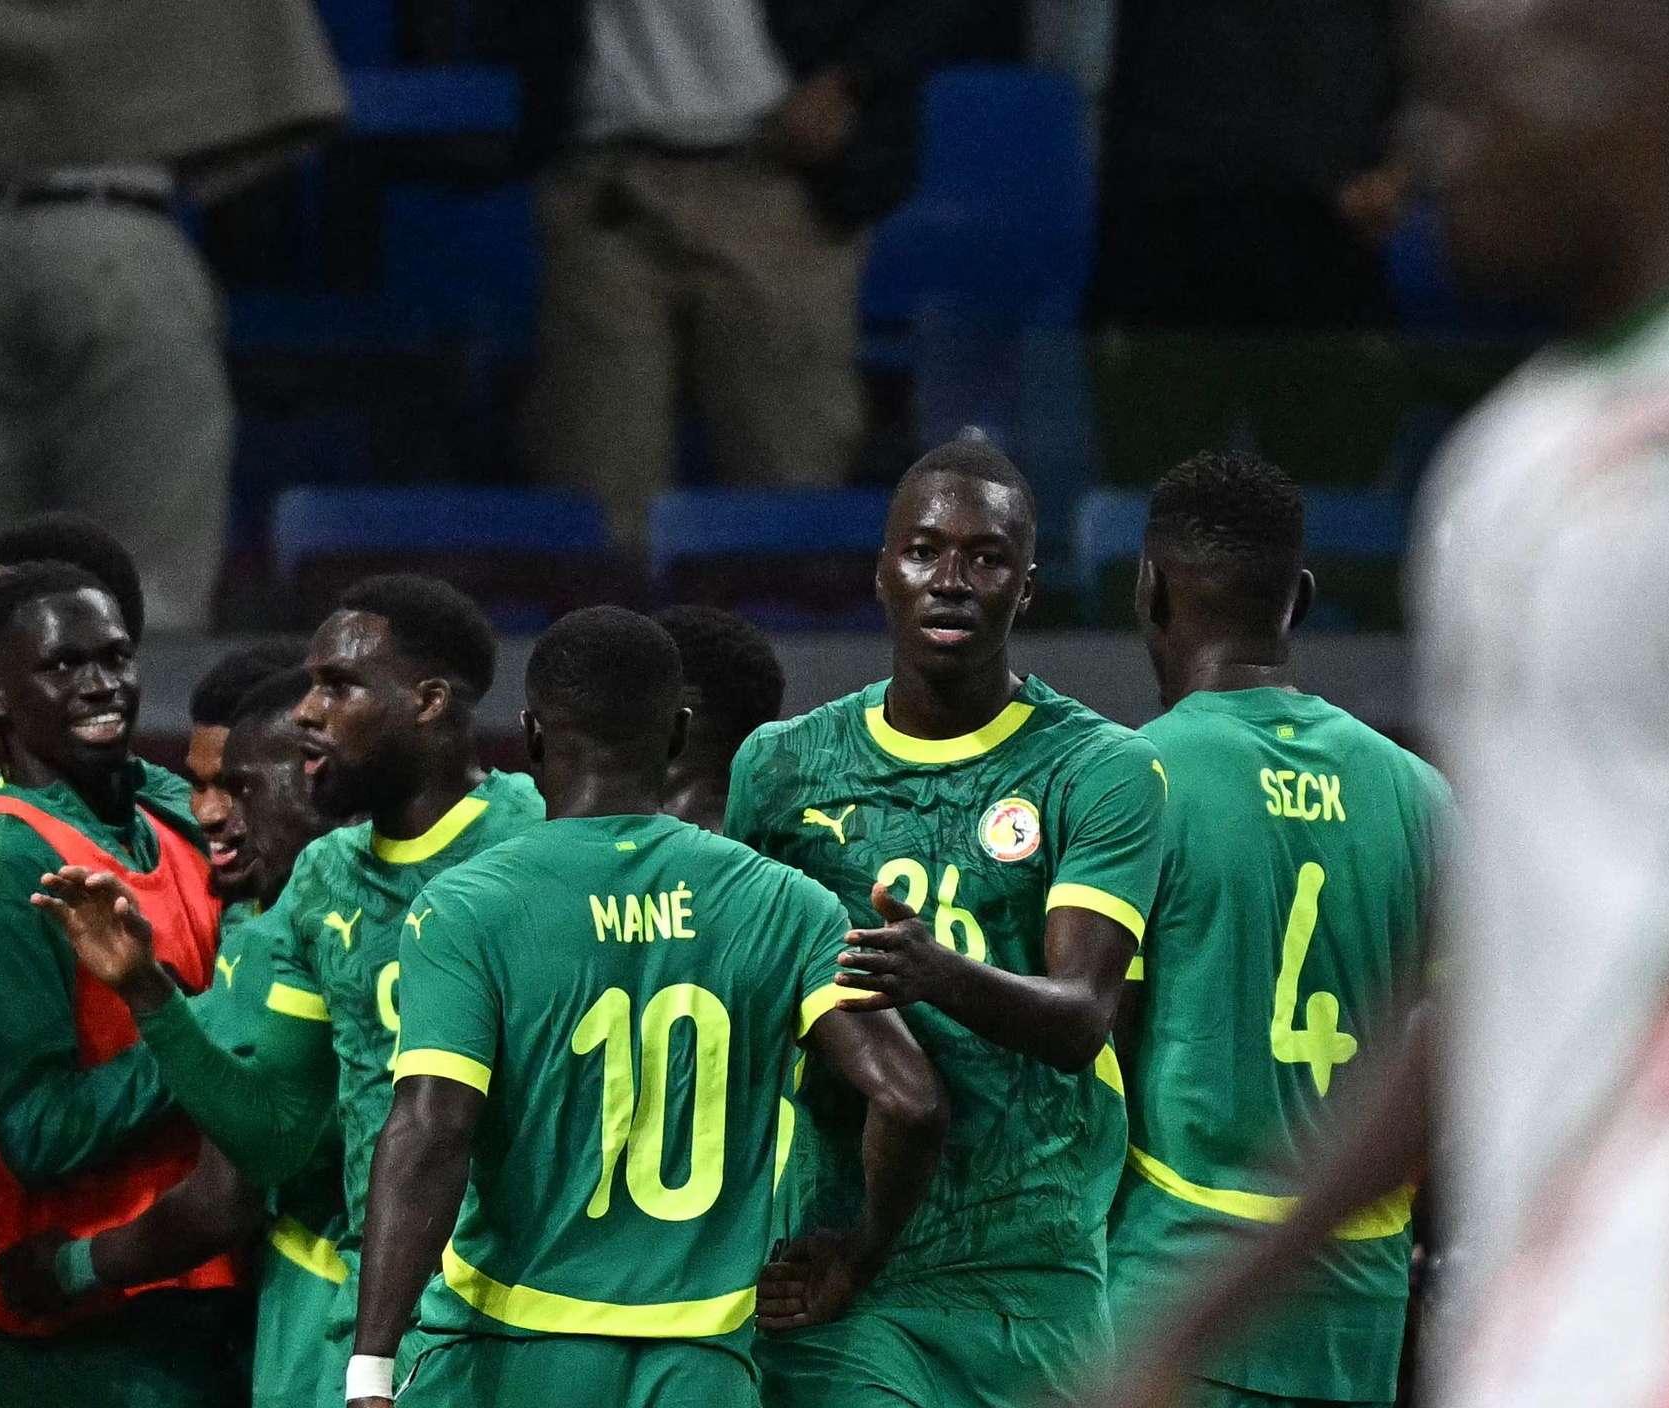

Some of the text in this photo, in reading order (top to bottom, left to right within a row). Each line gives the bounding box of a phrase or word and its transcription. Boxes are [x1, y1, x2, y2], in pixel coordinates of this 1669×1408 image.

[1260, 767, 1346, 822] SECK
[589, 880, 696, 943] MANÉ
[1271, 861, 1358, 1096] 4
[571, 982, 732, 1222] 10
